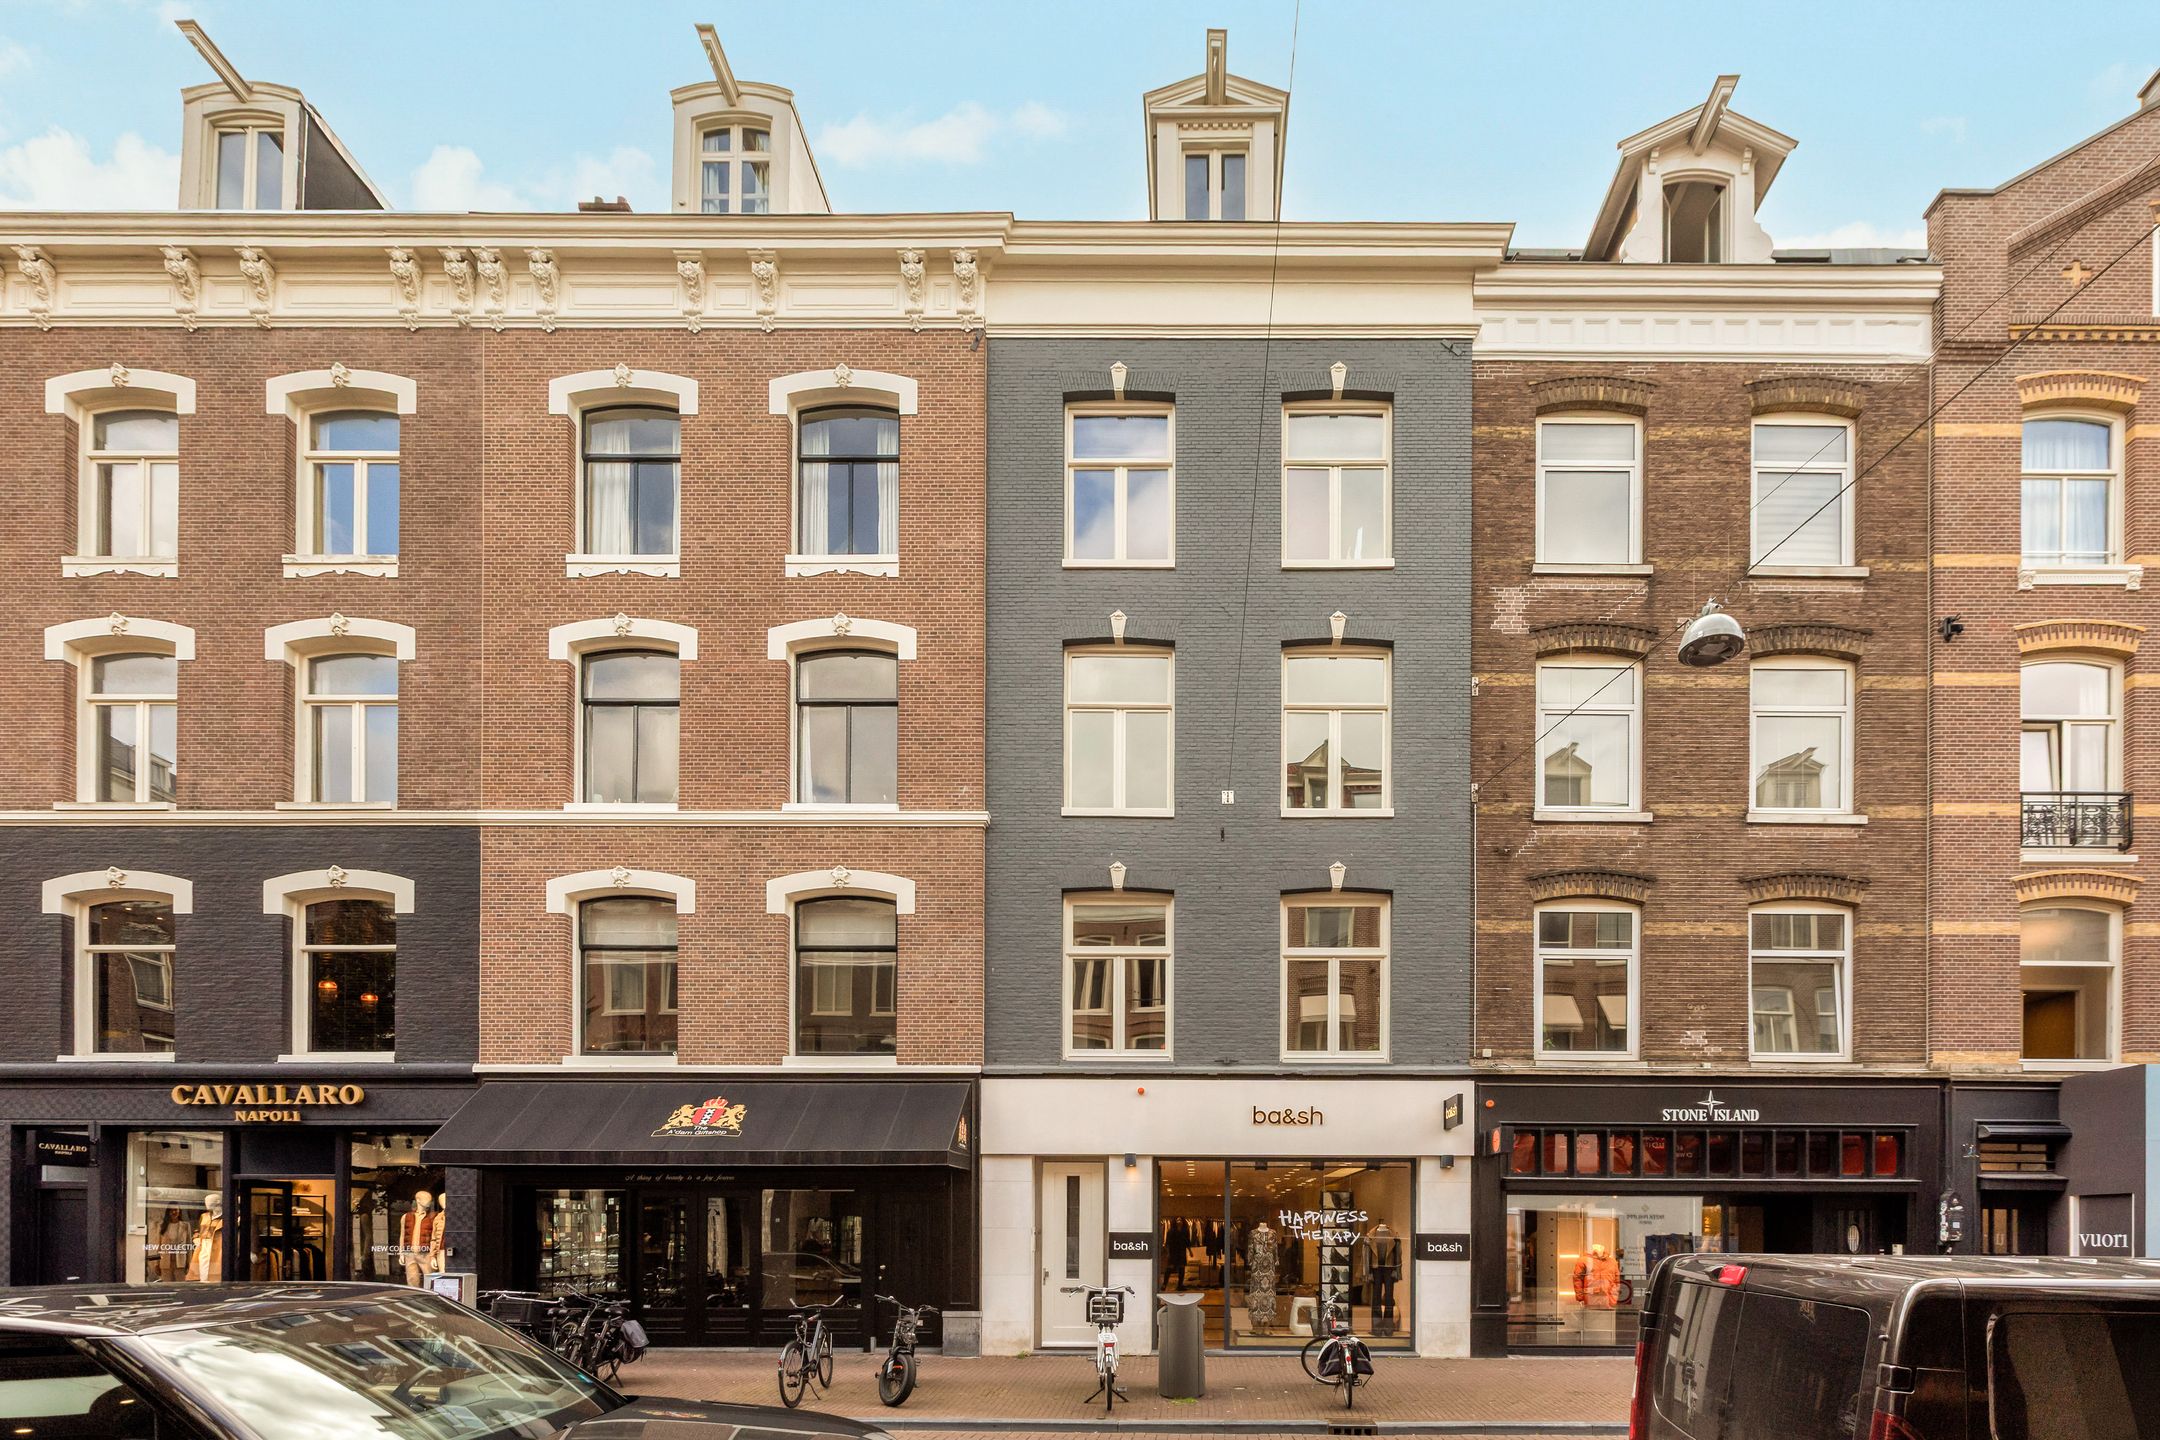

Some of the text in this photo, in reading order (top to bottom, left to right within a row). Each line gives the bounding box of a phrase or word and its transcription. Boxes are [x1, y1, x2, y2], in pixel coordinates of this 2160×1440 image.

[171, 1084, 365, 1105] CAVALLARO
[234, 1110, 301, 1122] NAPOLI
[1253, 1105, 1323, 1125] ba&sh
[1662, 1108, 1760, 1121] STONE ISLAND
[39, 1143, 87, 1152] CAVALLARO
[1289, 1225, 1361, 1245] THERAPY
[143, 1243, 202, 1251] NEW COLLECTIO
[1113, 1240, 1149, 1251] ba&sh
[1427, 1241, 1463, 1252] ba&sh
